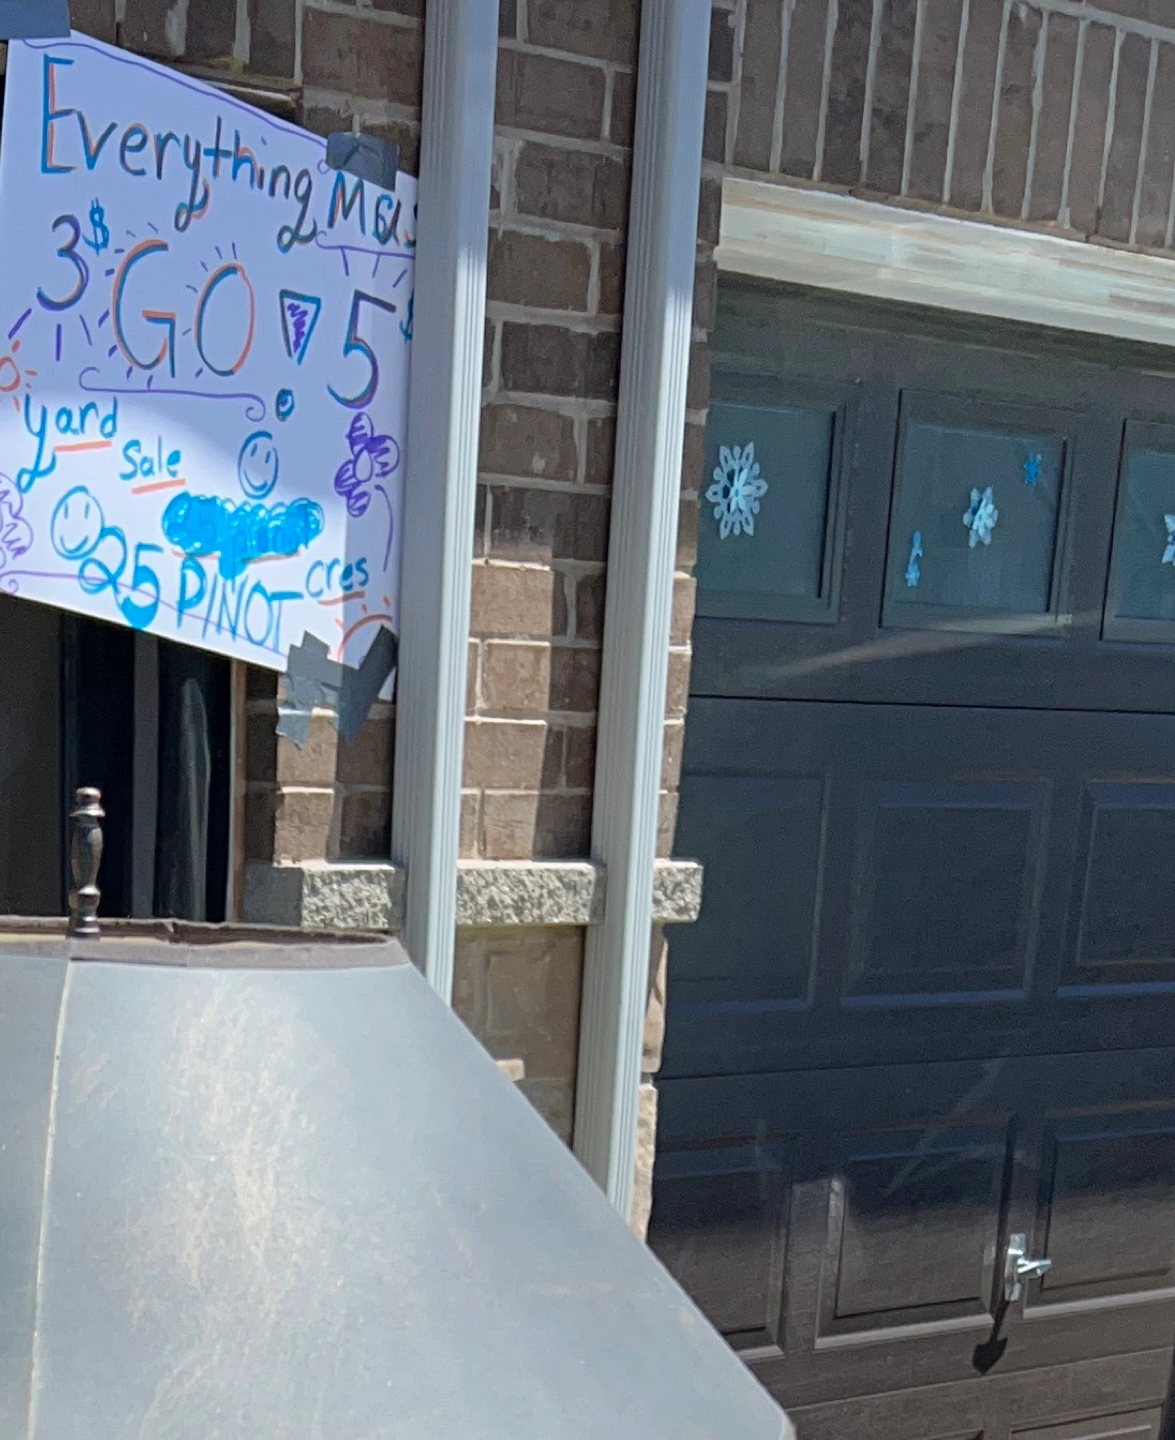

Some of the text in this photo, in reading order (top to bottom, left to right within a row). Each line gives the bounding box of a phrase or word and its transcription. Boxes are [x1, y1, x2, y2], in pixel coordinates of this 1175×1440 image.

[40, 52, 318, 254] Everything
[15, 391, 182, 495] yard Sale
[78, 525, 161, 632] 25
[304, 555, 370, 600] cres
